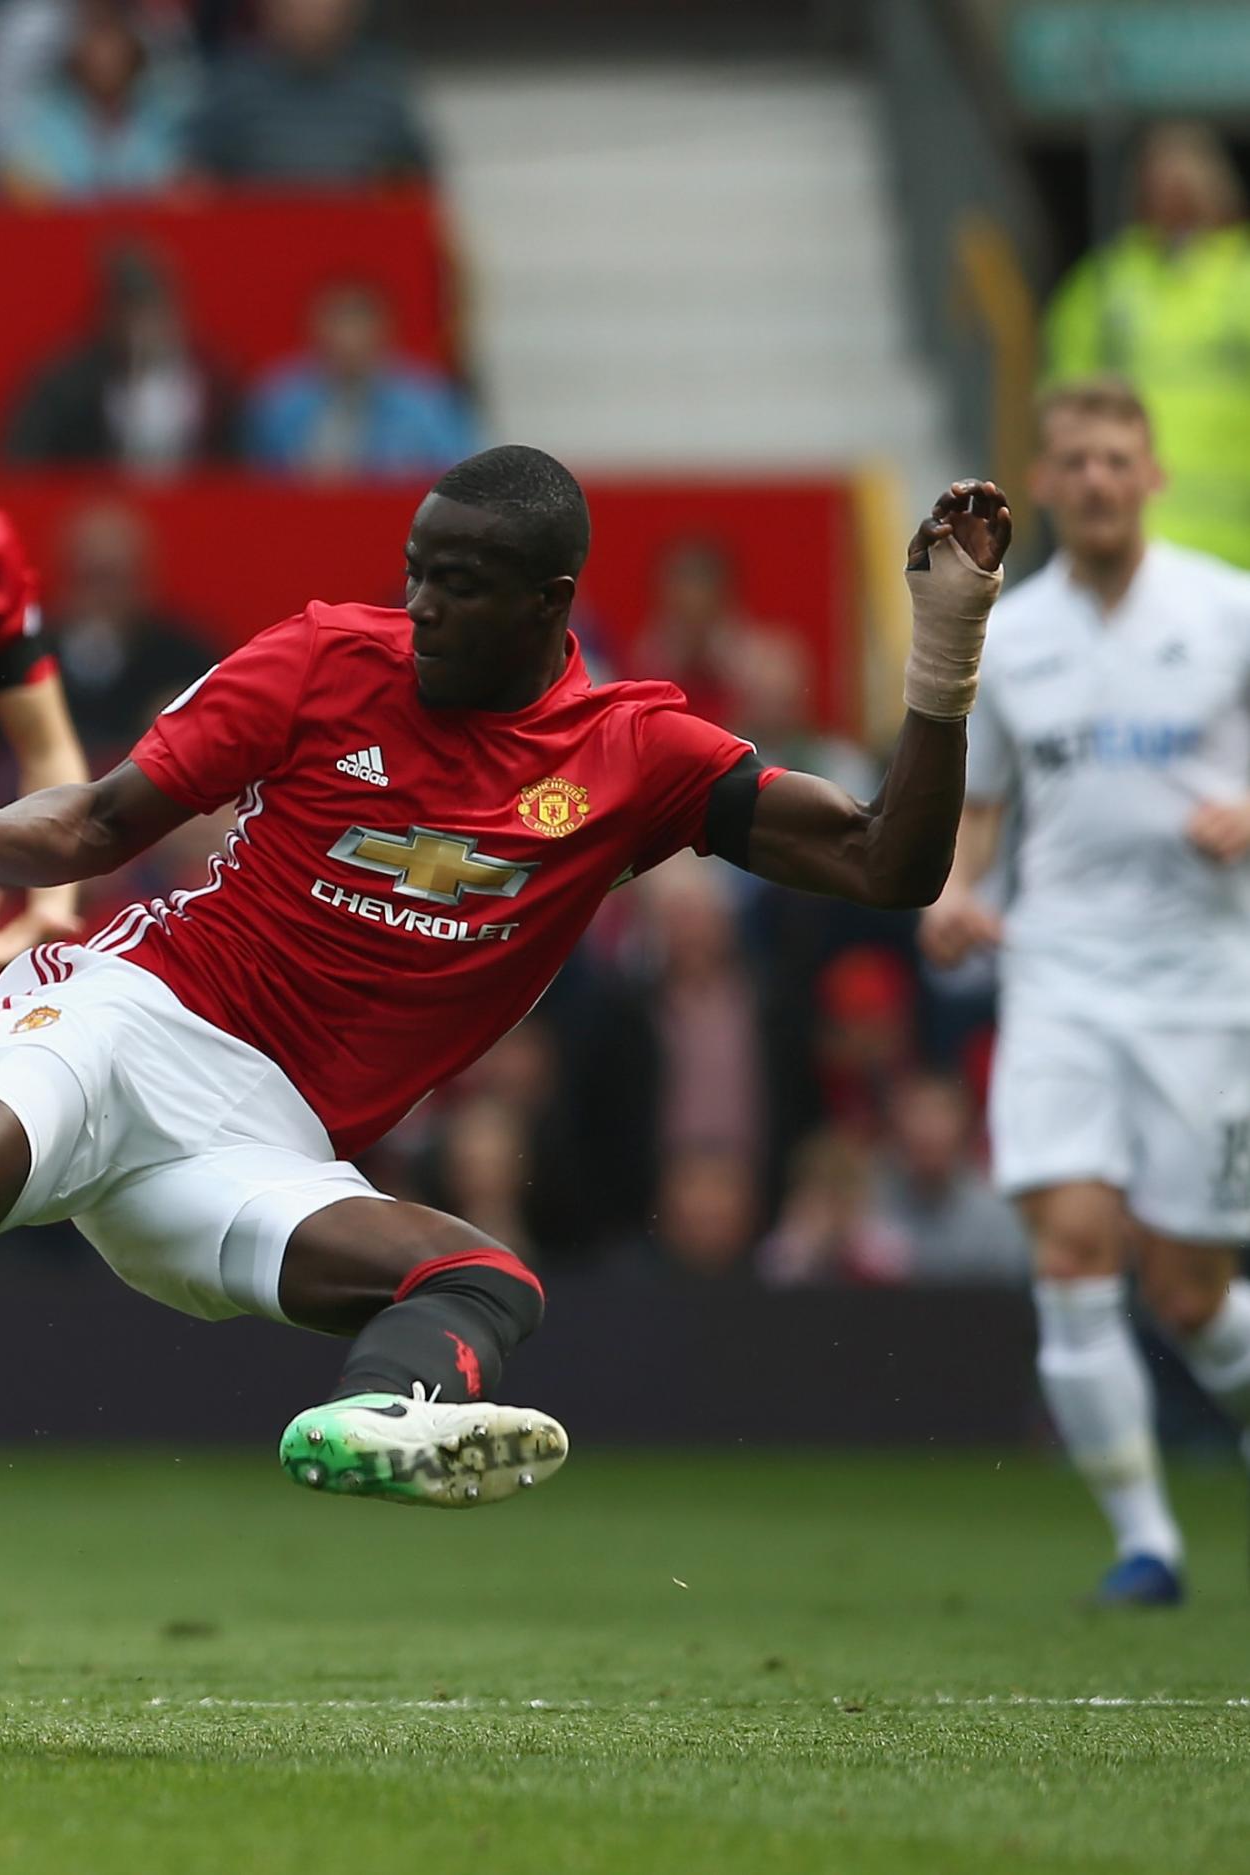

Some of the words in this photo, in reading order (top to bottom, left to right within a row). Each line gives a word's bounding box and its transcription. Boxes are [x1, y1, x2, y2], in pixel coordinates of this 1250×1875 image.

[336, 759, 389, 787] adidas
[526, 782, 583, 801] MANCHESTER
[534, 822, 575, 834] UNITED
[311, 879, 520, 942] CHEVROLET
